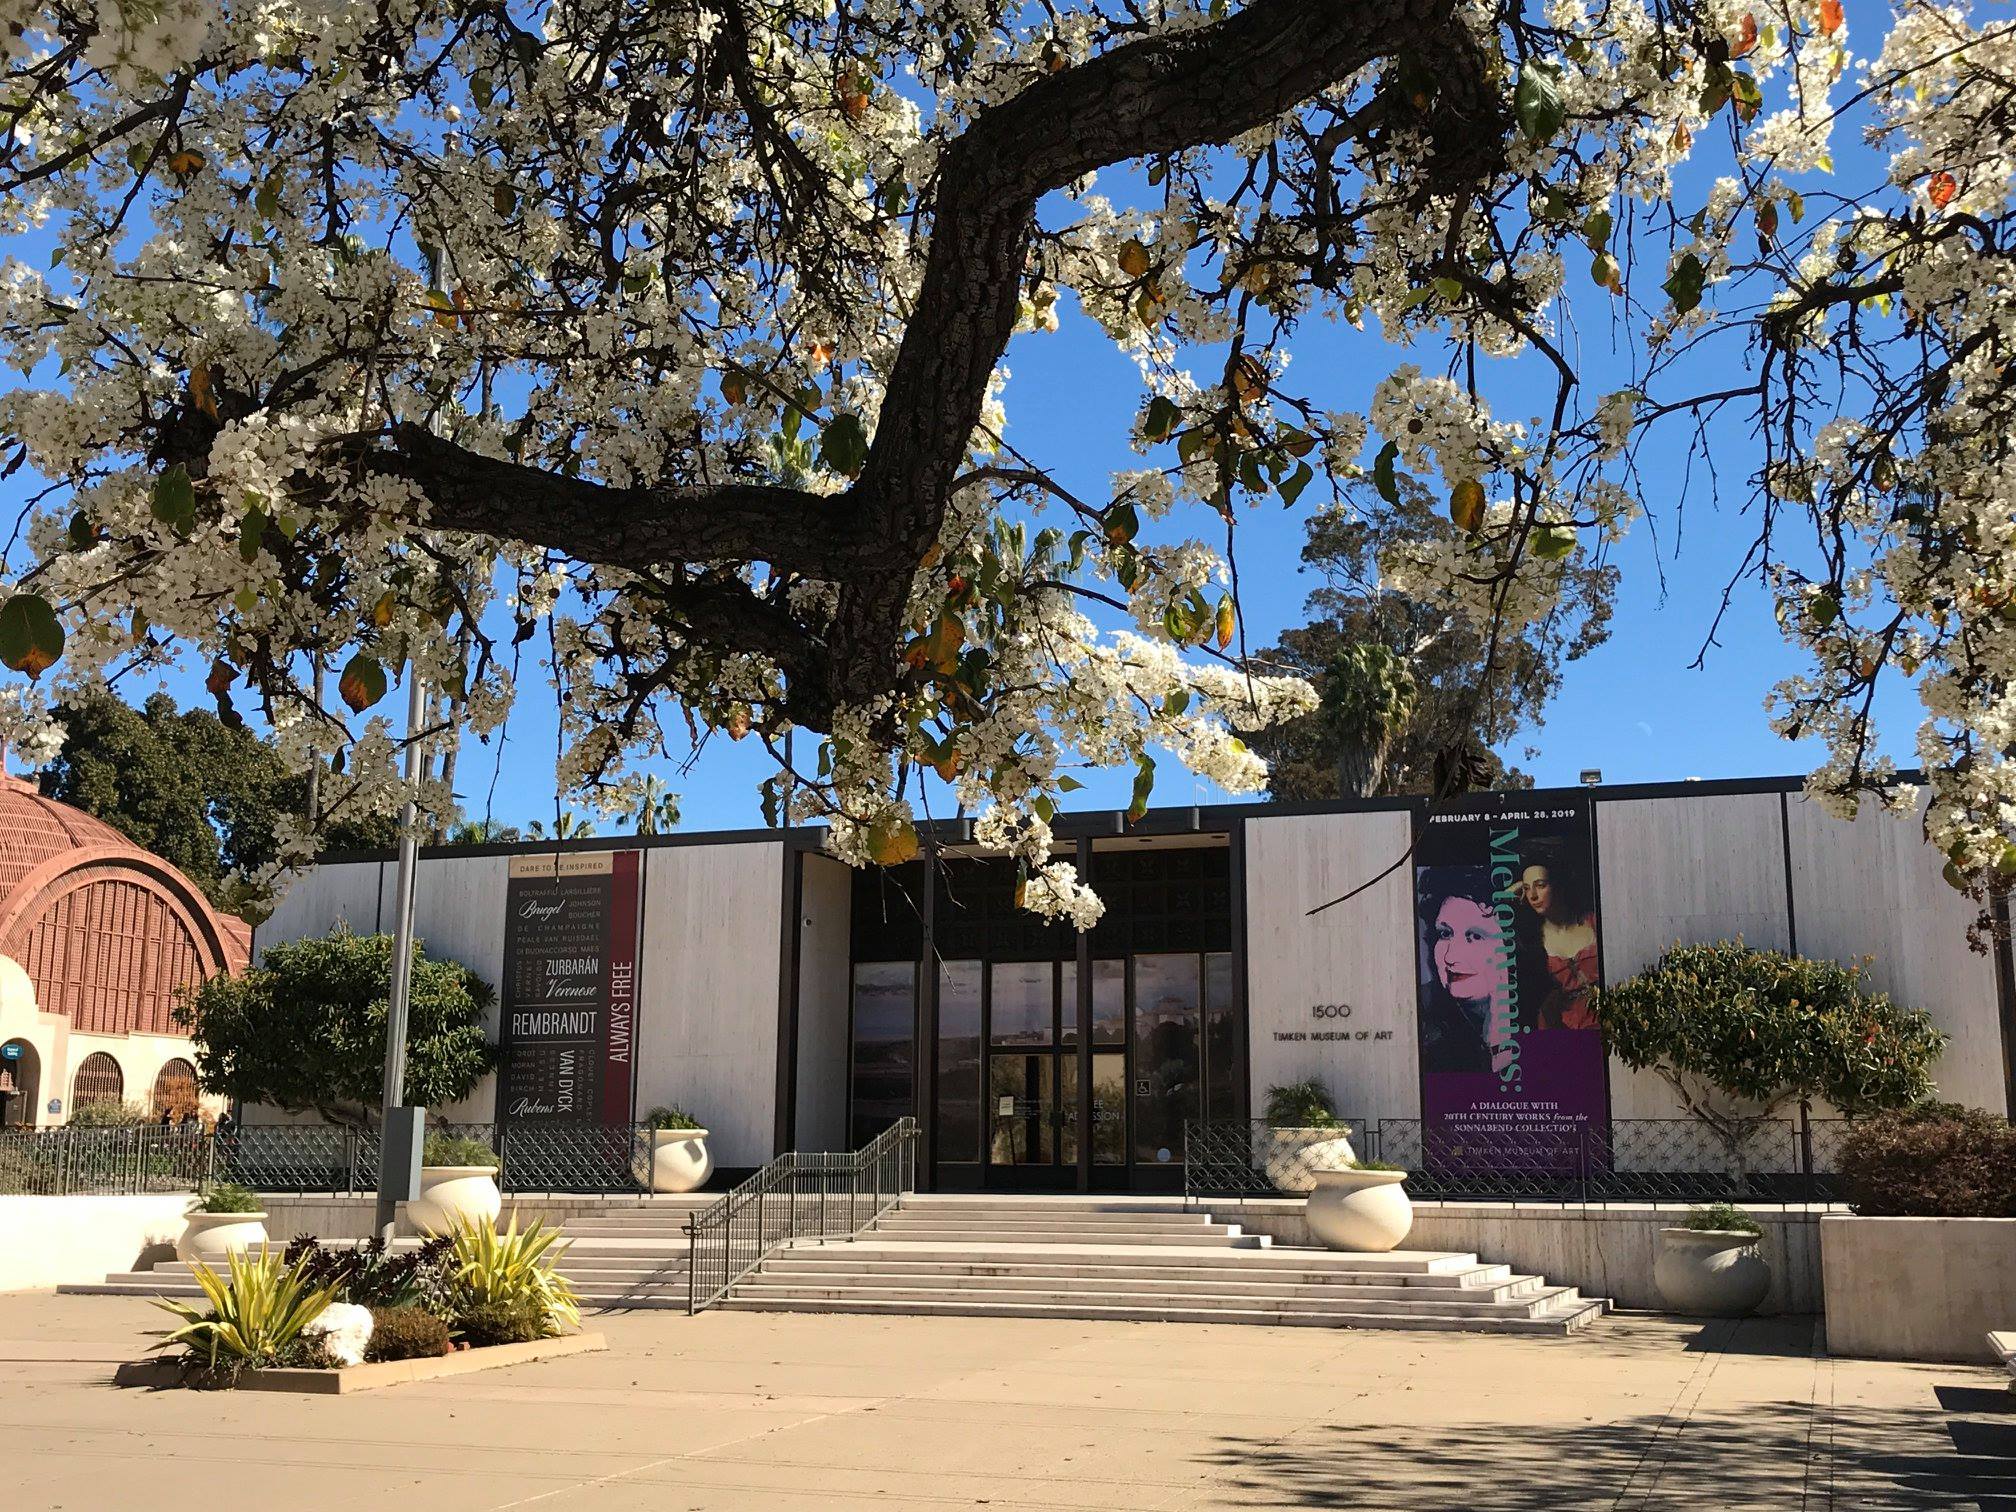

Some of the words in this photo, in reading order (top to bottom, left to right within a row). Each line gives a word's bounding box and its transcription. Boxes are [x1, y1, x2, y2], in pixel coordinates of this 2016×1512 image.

[1429, 813, 1481, 823] FEBRUARY
[1484, 812, 1491, 821] 8
[1500, 811, 1530, 820] APRIL
[1533, 810, 1550, 819] 28,
[1551, 809, 1576, 818] 2019
[520, 865, 540, 873] DARE
[542, 864, 552, 872] TO
[566, 862, 604, 871] INSPIRED
[519, 899, 566, 921] Bruegel
[545, 956, 599, 976] ZURBARÁN
[1487, 826, 1532, 1093] Metonymies:
[545, 978, 598, 999] Veronese
[611, 961, 633, 998] FREE
[1312, 1004, 1351, 1019] 1500
[512, 1011, 598, 1036] REMBRANDT
[609, 1002, 632, 1063] ALWAYS
[1273, 1032, 1306, 1041] TIMKEN
[1311, 1031, 1350, 1041] MUSEUM
[1355, 1031, 1368, 1040] OF
[1374, 1030, 1393, 1040] ART
[514, 1050, 536, 1058] OROT
[559, 1050, 575, 1075] VAN
[557, 1079, 574, 1113] DYCK
[1470, 1102, 1478, 1110] A
[1479, 1102, 1530, 1110] DIALOGUE
[1531, 1102, 1558, 1110] WITH
[508, 1097, 554, 1117] Rubens
[1469, 1113, 1515, 1121] CENTURY
[1516, 1113, 1551, 1121] WORKS
[1552, 1113, 1574, 1122] from
[1575, 1112, 1589, 1121] the
[1454, 1124, 1513, 1133] SONNABEND
[1504, 1147, 1542, 1155] MUSEUM
